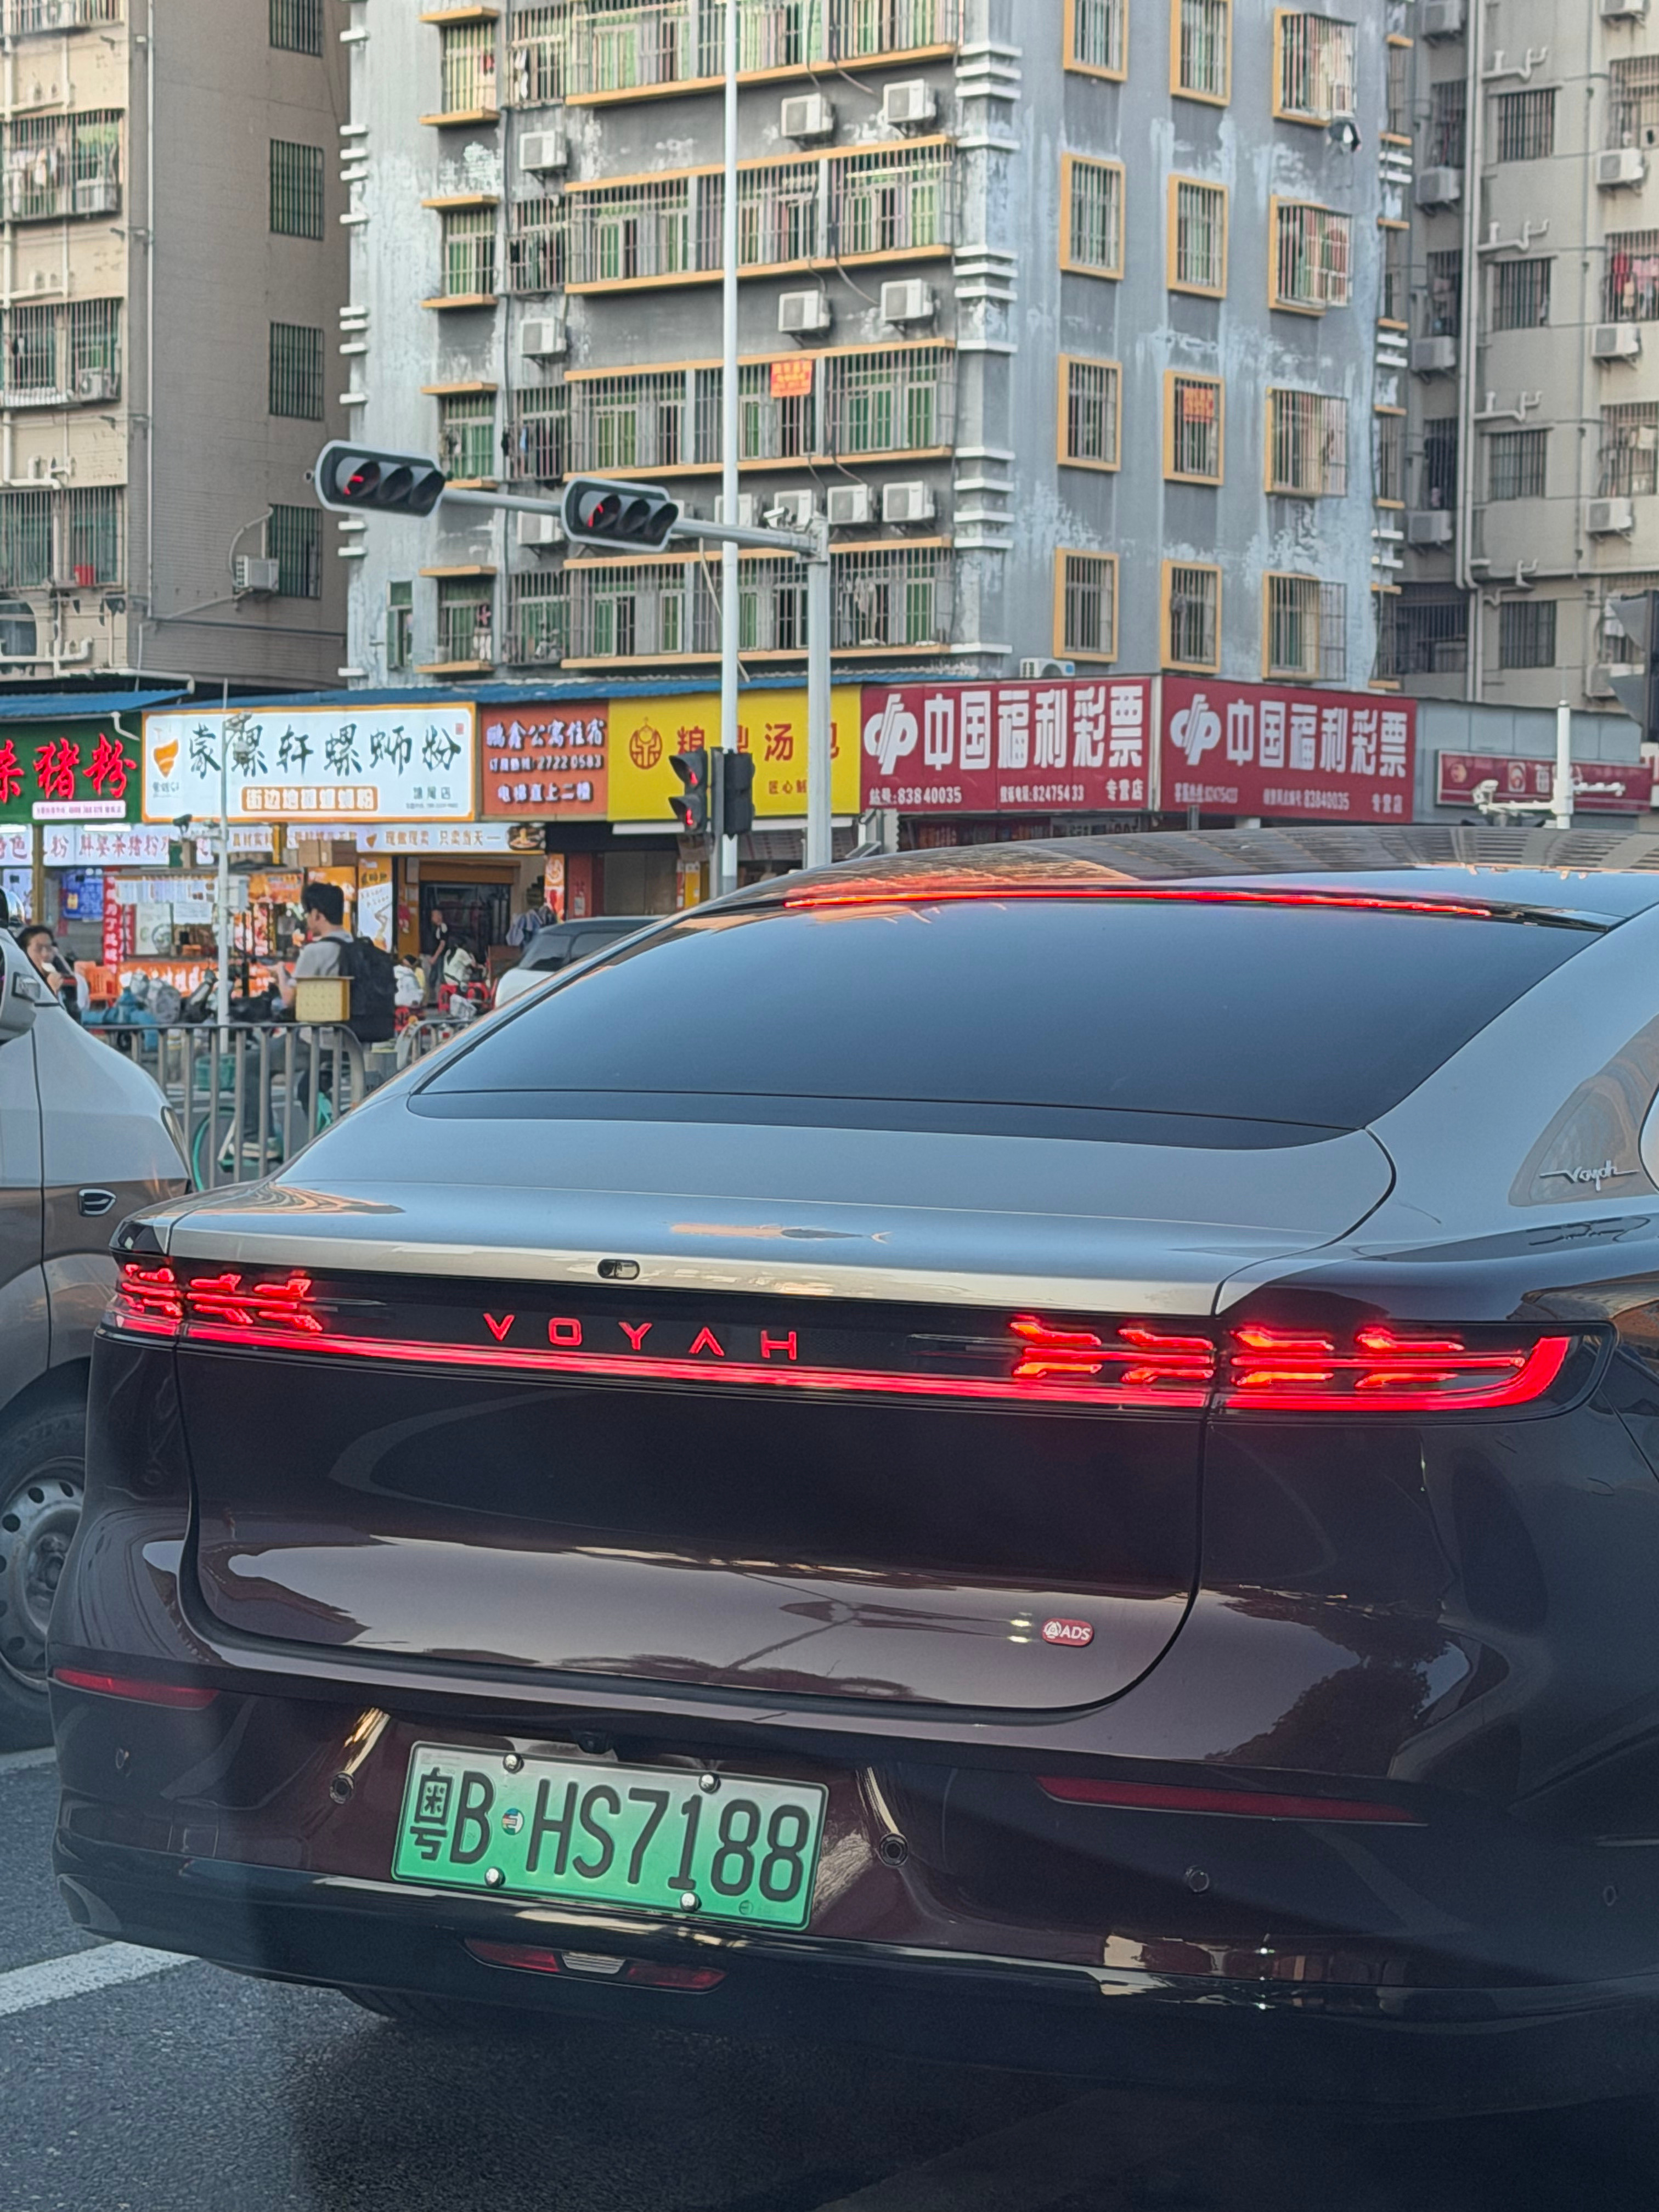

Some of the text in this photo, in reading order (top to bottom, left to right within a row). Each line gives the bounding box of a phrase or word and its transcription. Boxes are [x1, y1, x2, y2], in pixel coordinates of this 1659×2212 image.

[924, 685, 1143, 770] 中国福利彩票
[1227, 698, 1407, 777] 中国福利彩票
[483, 1313, 797, 1361] VOYAH
[1059, 1624, 1091, 1641] ADS
[410, 1767, 811, 1903] 粤B HS7188
